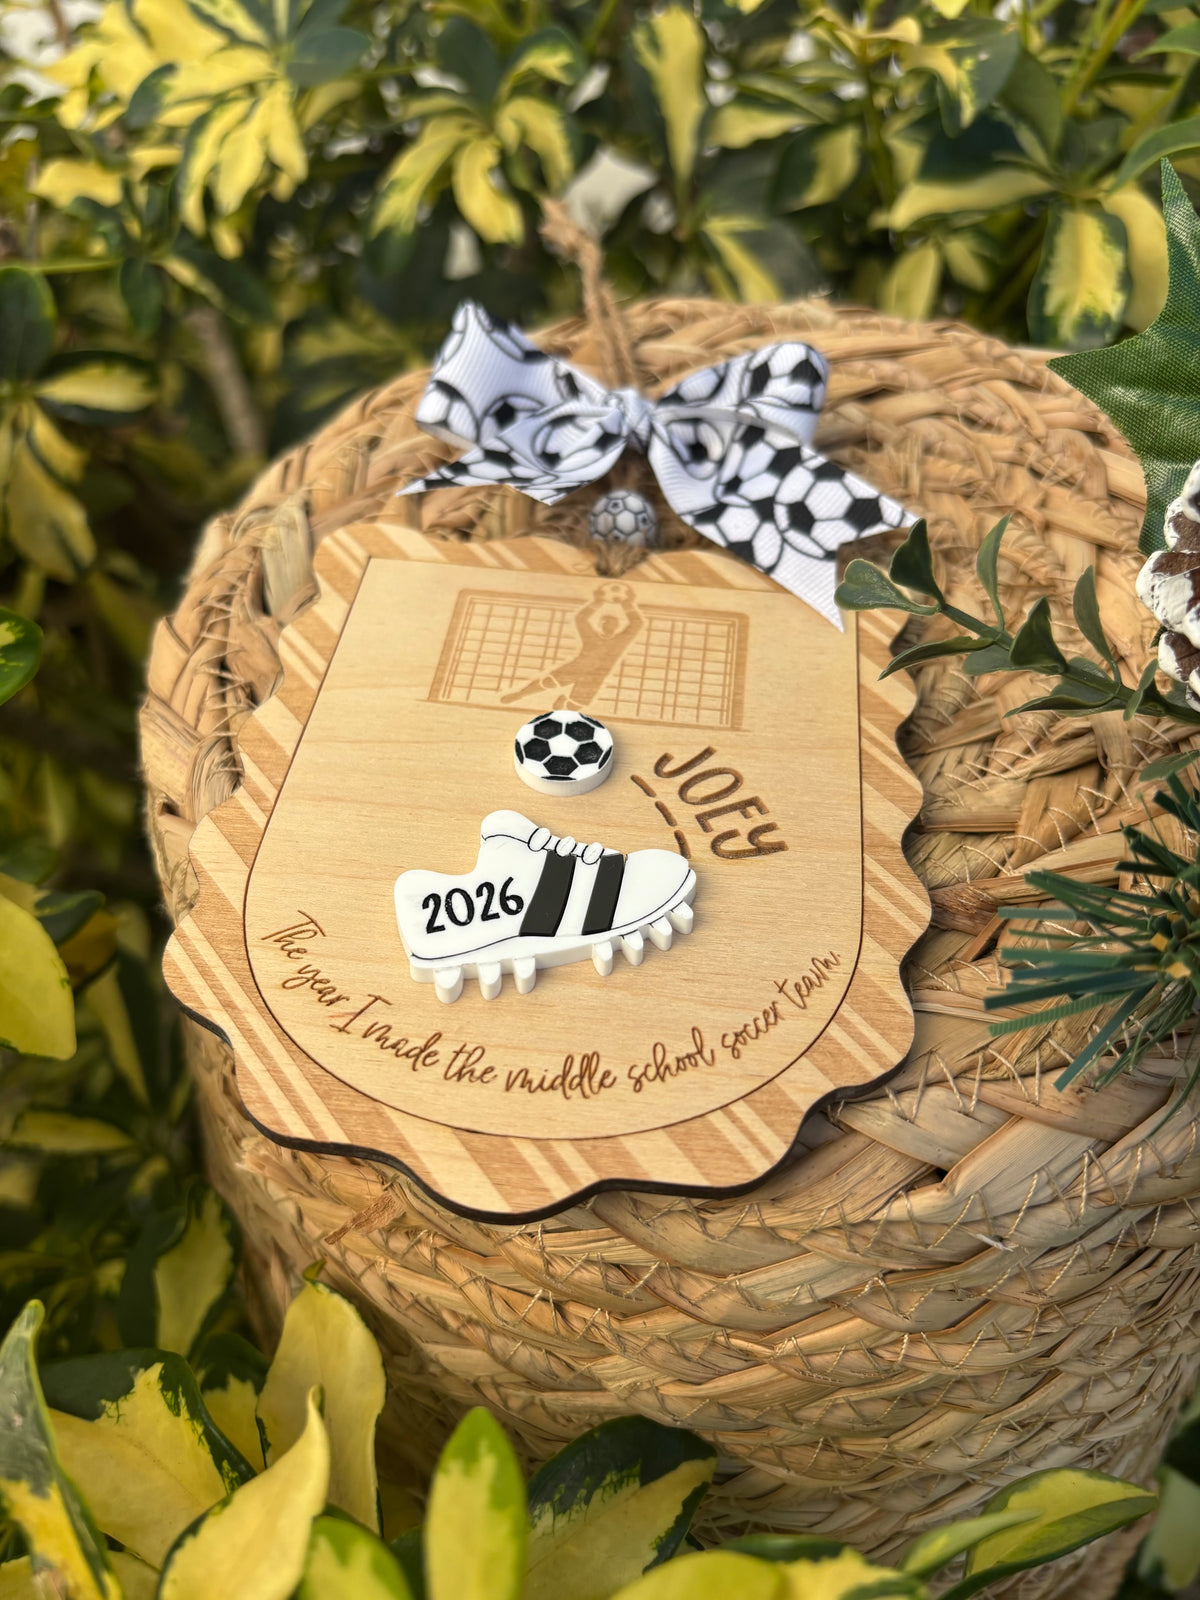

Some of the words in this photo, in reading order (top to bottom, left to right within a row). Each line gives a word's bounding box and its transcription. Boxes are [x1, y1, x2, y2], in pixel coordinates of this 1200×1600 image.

[653, 745, 789, 860] JOEY
[421, 876, 525, 934] 2026
[260, 910, 327, 960] The
[281, 963, 351, 1007] year
[773, 950, 841, 1011] team.
[329, 993, 393, 1035] I
[720, 1000, 786, 1060] soccer
[361, 1021, 444, 1072] made
[443, 1042, 498, 1085] the
[627, 1026, 717, 1094] school
[504, 1051, 617, 1101] middle
